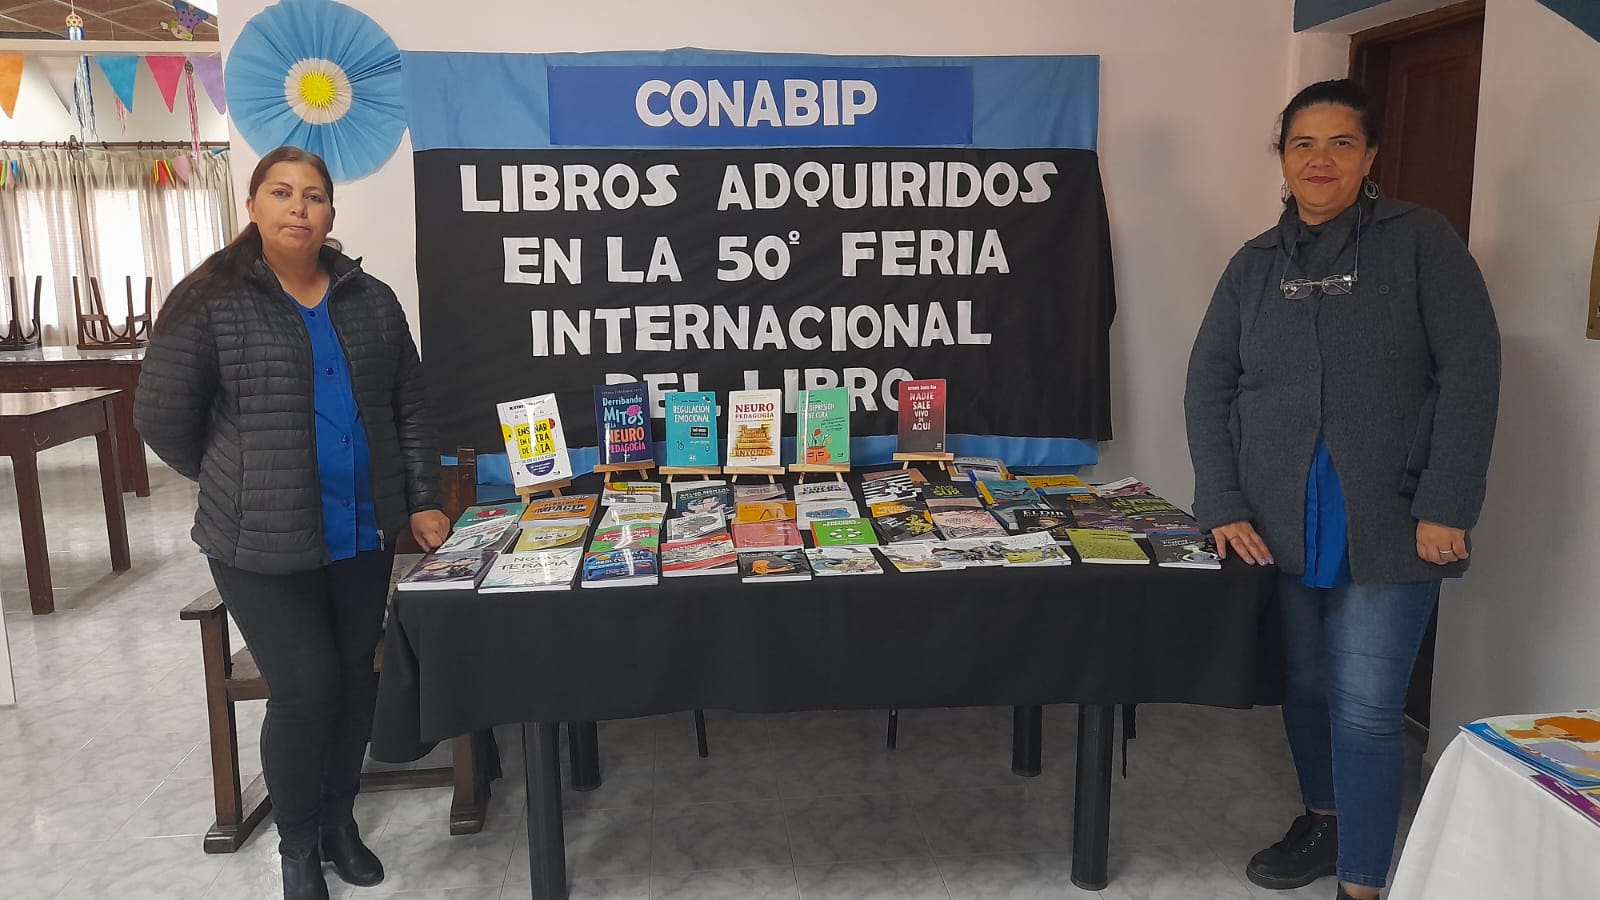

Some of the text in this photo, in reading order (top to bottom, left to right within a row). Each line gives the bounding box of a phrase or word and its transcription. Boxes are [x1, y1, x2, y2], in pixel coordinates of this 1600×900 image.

[635, 79, 878, 128] CONABIP
[459, 161, 1059, 213] LIBROS ADQUIRIDOS
[502, 236, 582, 285] EN
[606, 236, 683, 284] LA
[841, 229, 1010, 277] FERIA
[530, 300, 992, 357] INTERNACIONAL
[602, 394, 643, 407] Derribando
[909, 392, 935, 401] NADIE
[673, 403, 710, 414] REGULACIÓN
[735, 402, 774, 413] NEURO
[912, 401, 931, 410] SALE
[604, 406, 644, 426] MITOS
[674, 413, 710, 423] EMOCIONAL
[914, 409, 929, 418] VIVO
[912, 420, 932, 431] AQUÍ
